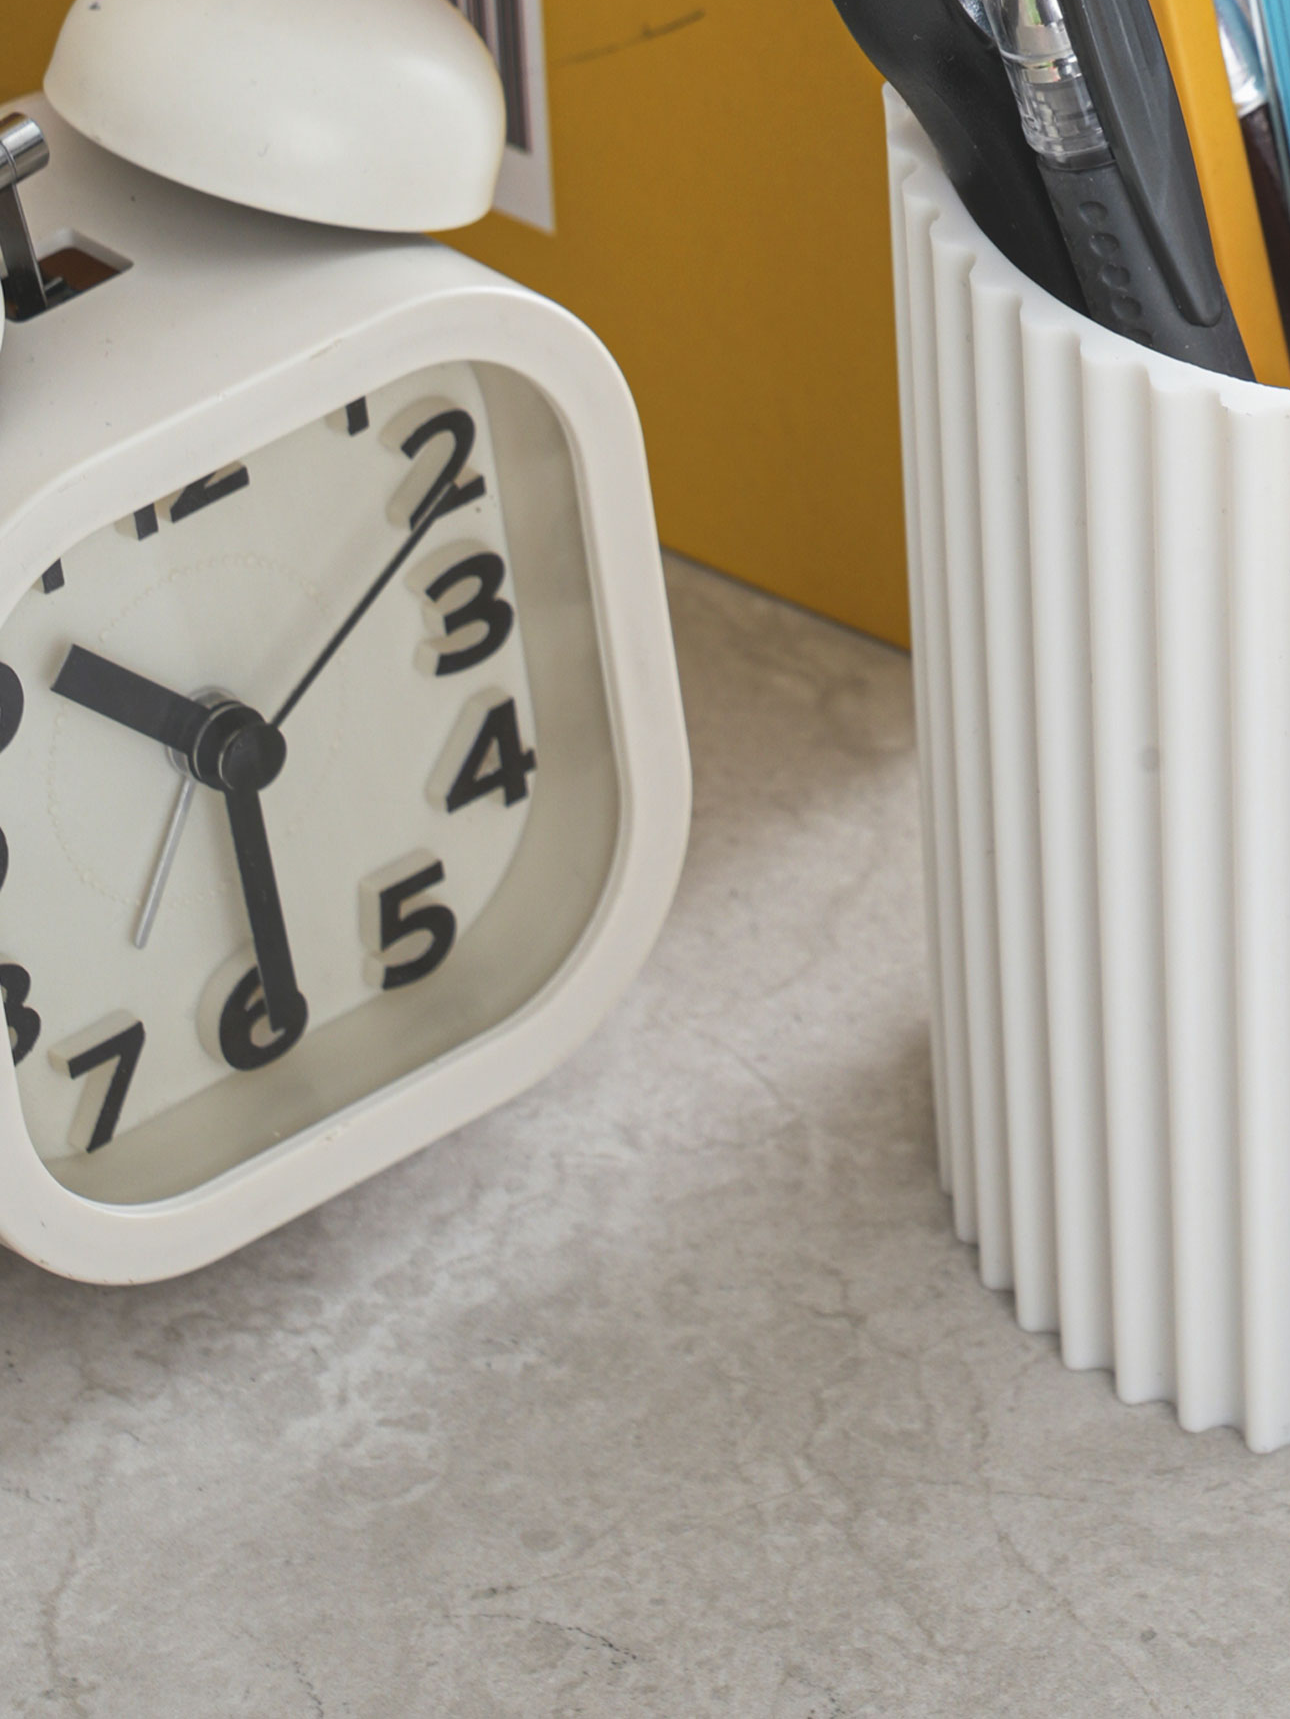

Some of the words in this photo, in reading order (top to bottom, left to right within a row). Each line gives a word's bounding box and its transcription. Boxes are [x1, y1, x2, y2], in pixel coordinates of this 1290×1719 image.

[400, 408, 487, 532] 2
[424, 551, 515, 677] 3
[444, 697, 538, 814] 4
[378, 858, 457, 991] 5
[218, 964, 310, 1072] 6
[67, 1020, 147, 1154] 7
